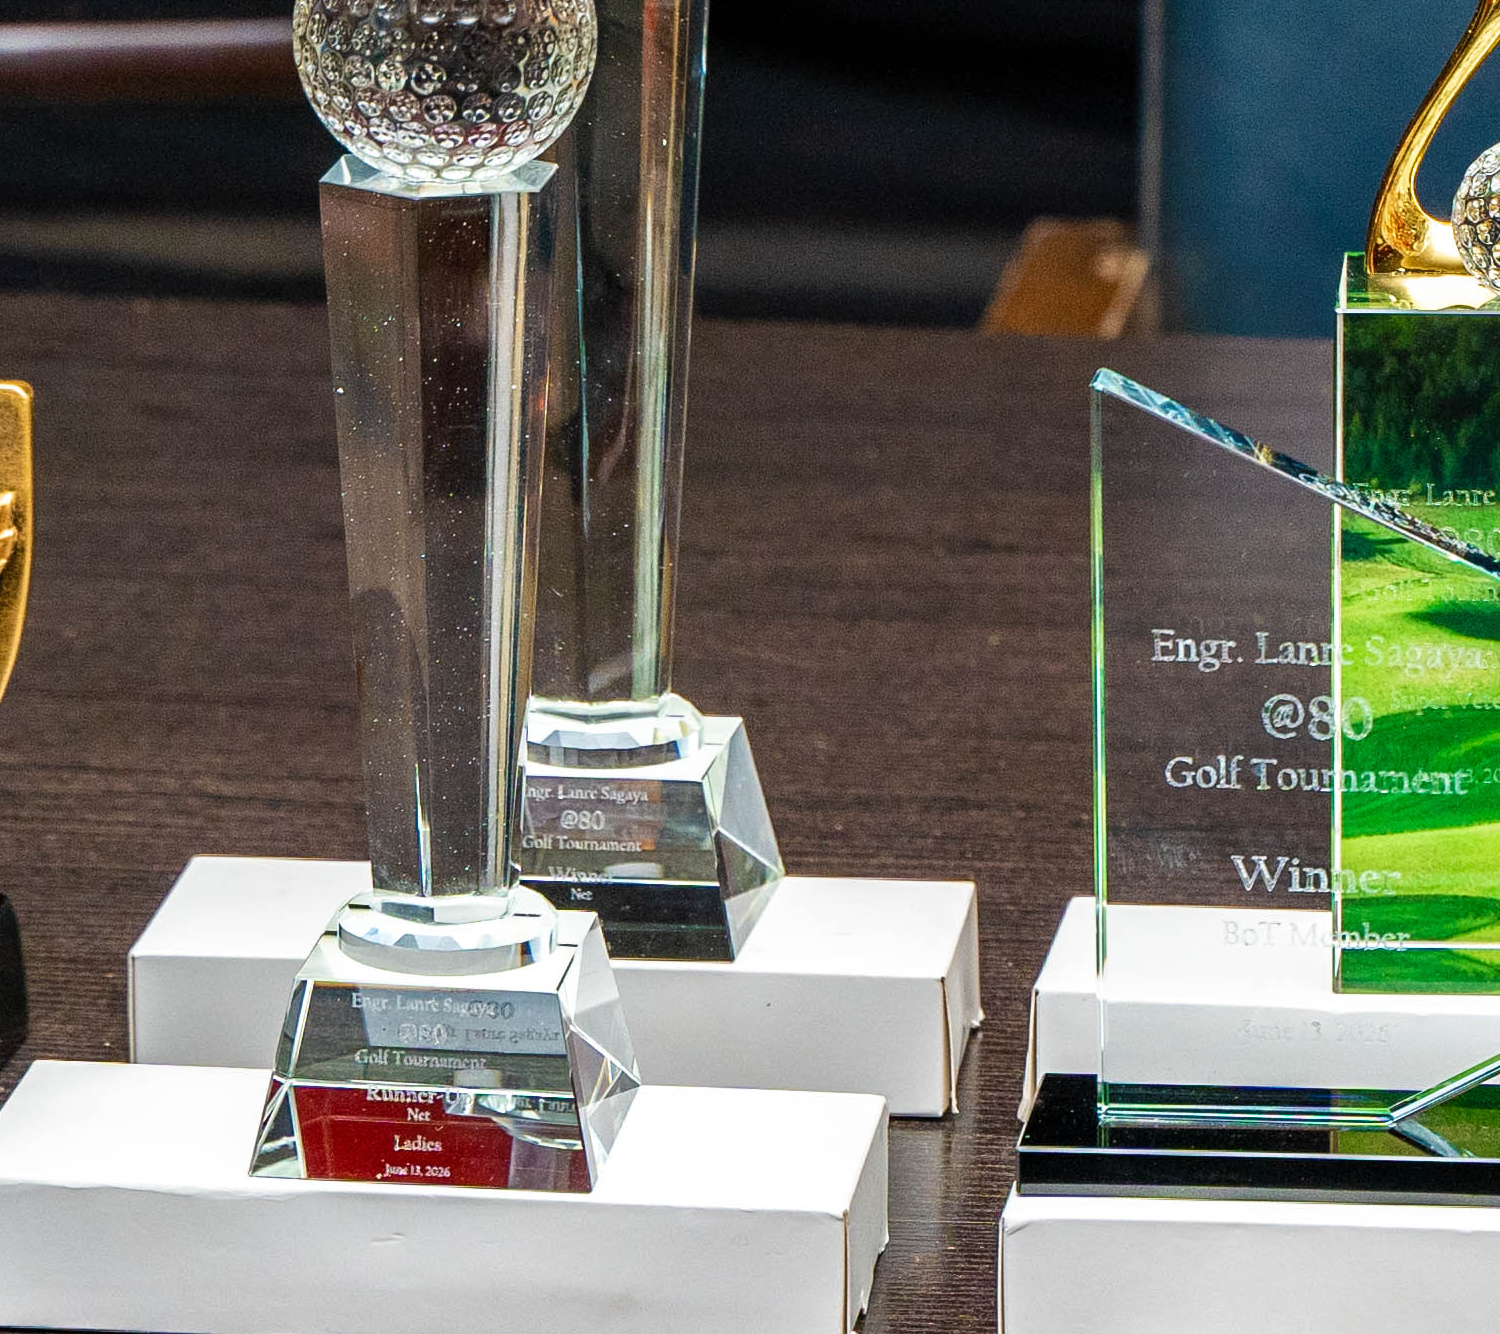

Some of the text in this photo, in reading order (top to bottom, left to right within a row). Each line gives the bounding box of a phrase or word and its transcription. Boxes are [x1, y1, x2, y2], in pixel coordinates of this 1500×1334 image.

[1426, 483, 1495, 507] Lanre
[1150, 629, 1244, 673] Engr.
[1254, 631, 1354, 667] Lanre
[1365, 635, 1487, 679] Sagaya
[1261, 693, 1374, 742] @80
[1164, 755, 1469, 796] Golf Tournament
[525, 784, 648, 805] ngr. Lanre Sagaya
[560, 809, 606, 831] @80
[522, 835, 642, 853] Golf Tournament
[1230, 854, 1402, 896] Winner
[1221, 919, 1412, 953] BoT Member
[351, 991, 392, 1013] Engr.
[396, 993, 439, 1012] Lanre
[354, 1048, 488, 1070] Golf Tournament
[406, 1107, 431, 1121] Net
[393, 1134, 443, 1152] Ladies
[425, 1165, 451, 1178] 2026
